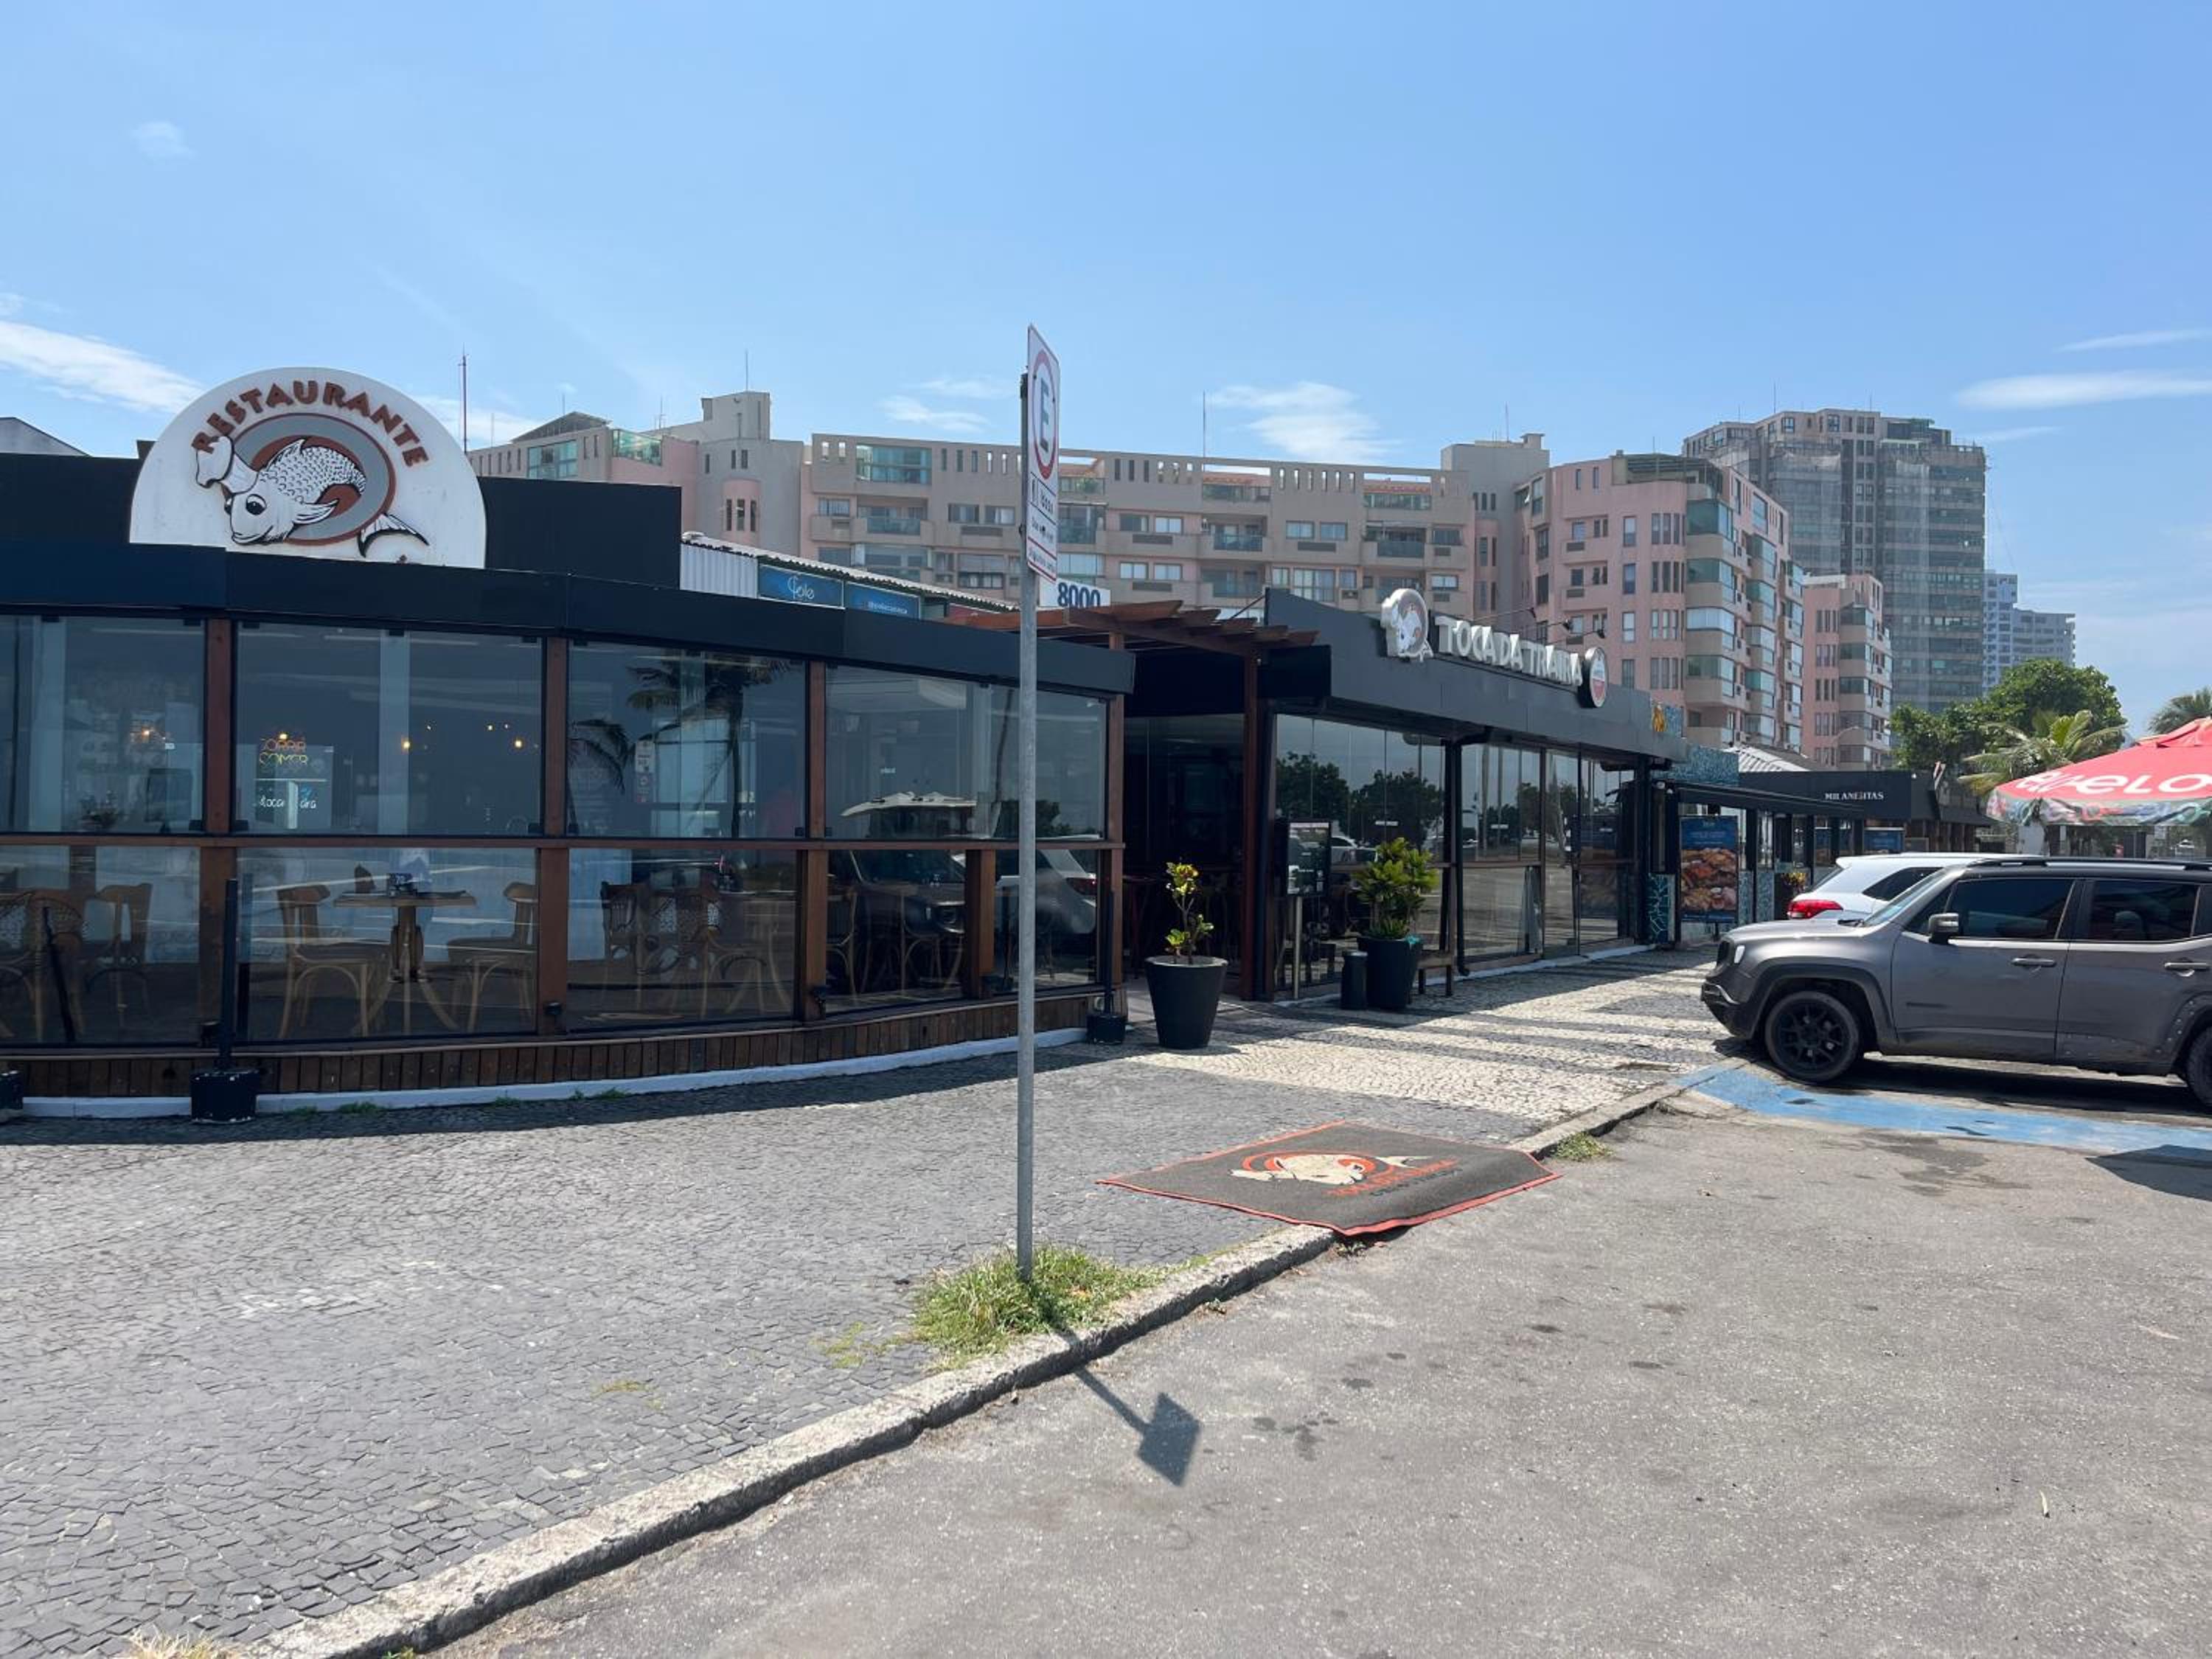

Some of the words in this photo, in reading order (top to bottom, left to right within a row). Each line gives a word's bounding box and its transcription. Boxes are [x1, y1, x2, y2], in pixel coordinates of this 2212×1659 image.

[191, 380, 429, 467] RESTAURANTE
[1057, 582, 1101, 608] 8000
[1435, 616, 1497, 665] TOCA
[1495, 632, 1523, 671] DA
